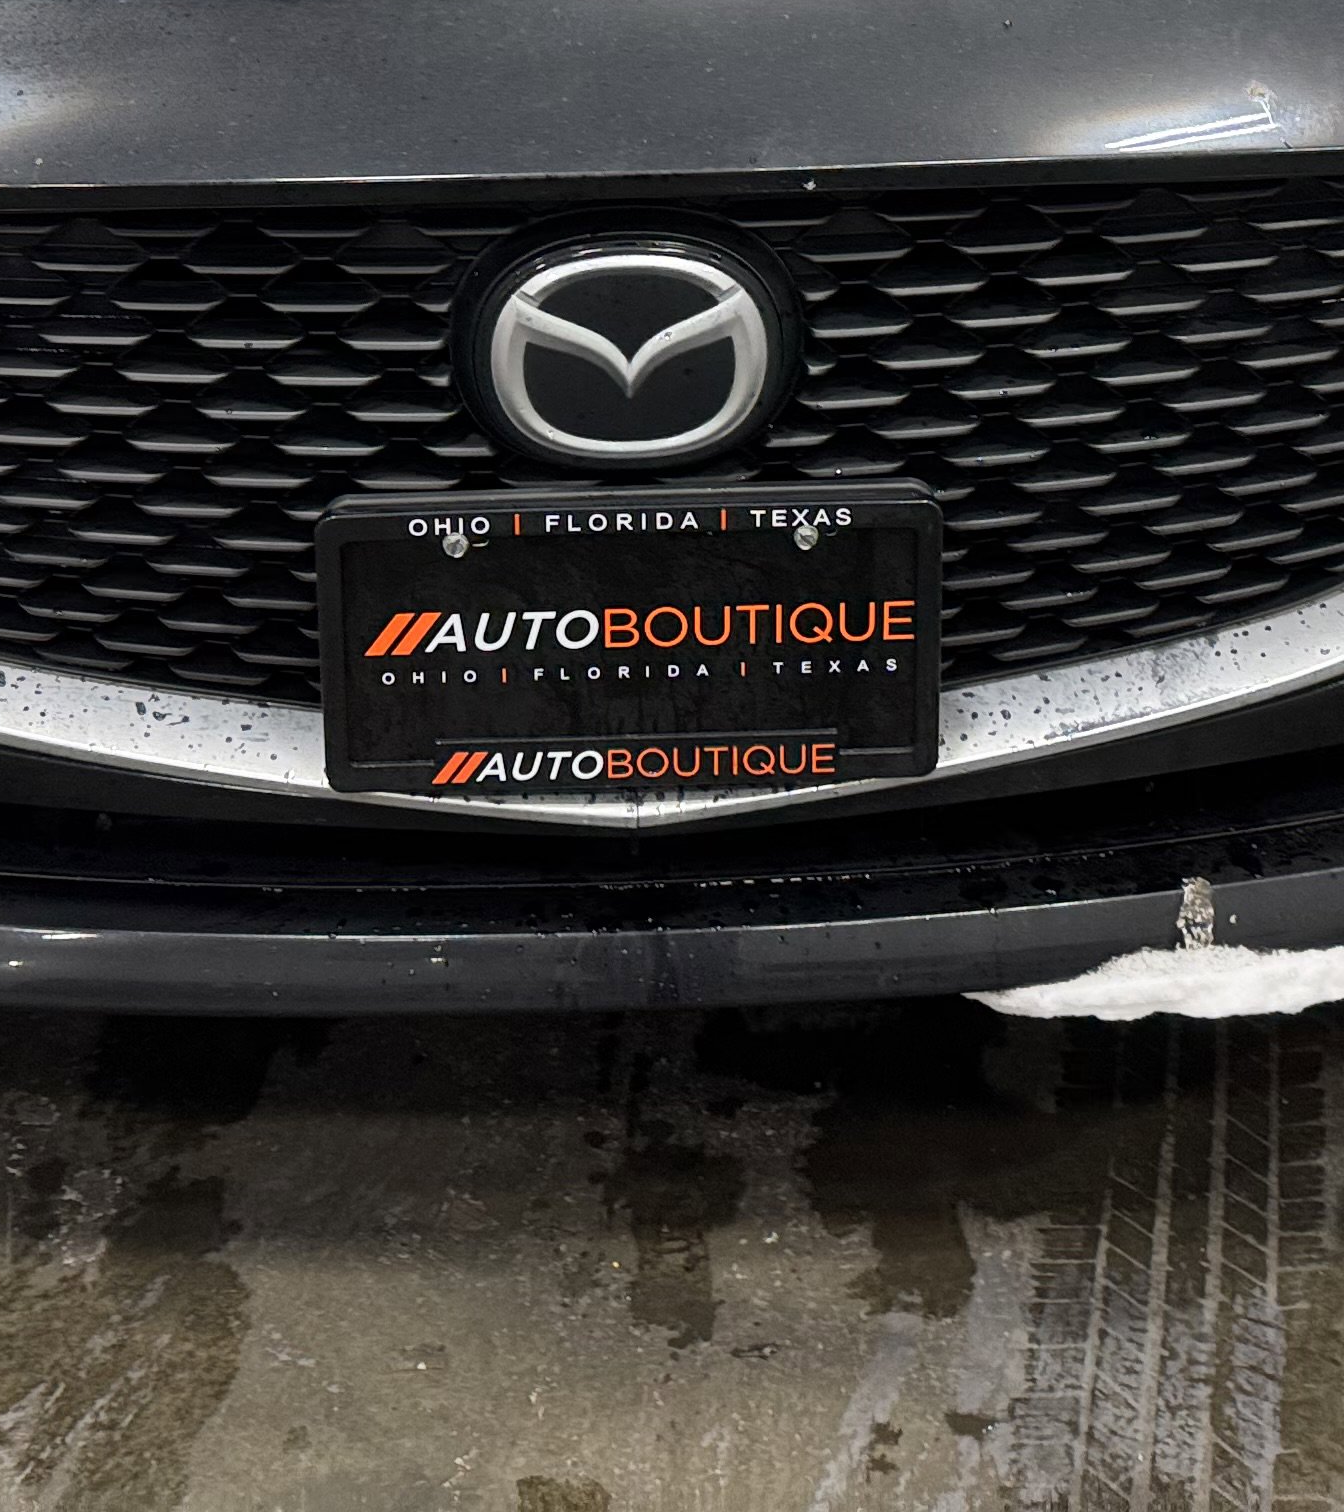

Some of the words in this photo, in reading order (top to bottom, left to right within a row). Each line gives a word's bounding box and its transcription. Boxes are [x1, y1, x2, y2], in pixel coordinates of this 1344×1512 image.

[408, 516, 490, 537] OHIO
[545, 511, 699, 533] FLORIDA
[749, 507, 852, 528] TEXAS
[425, 600, 916, 654] AUTOBOUTIQUE
[381, 669, 478, 686] OHIO
[533, 663, 710, 682] FLORIDA
[772, 657, 899, 675] TEXAS
[476, 743, 837, 784] AUTOBOUTIQUE
